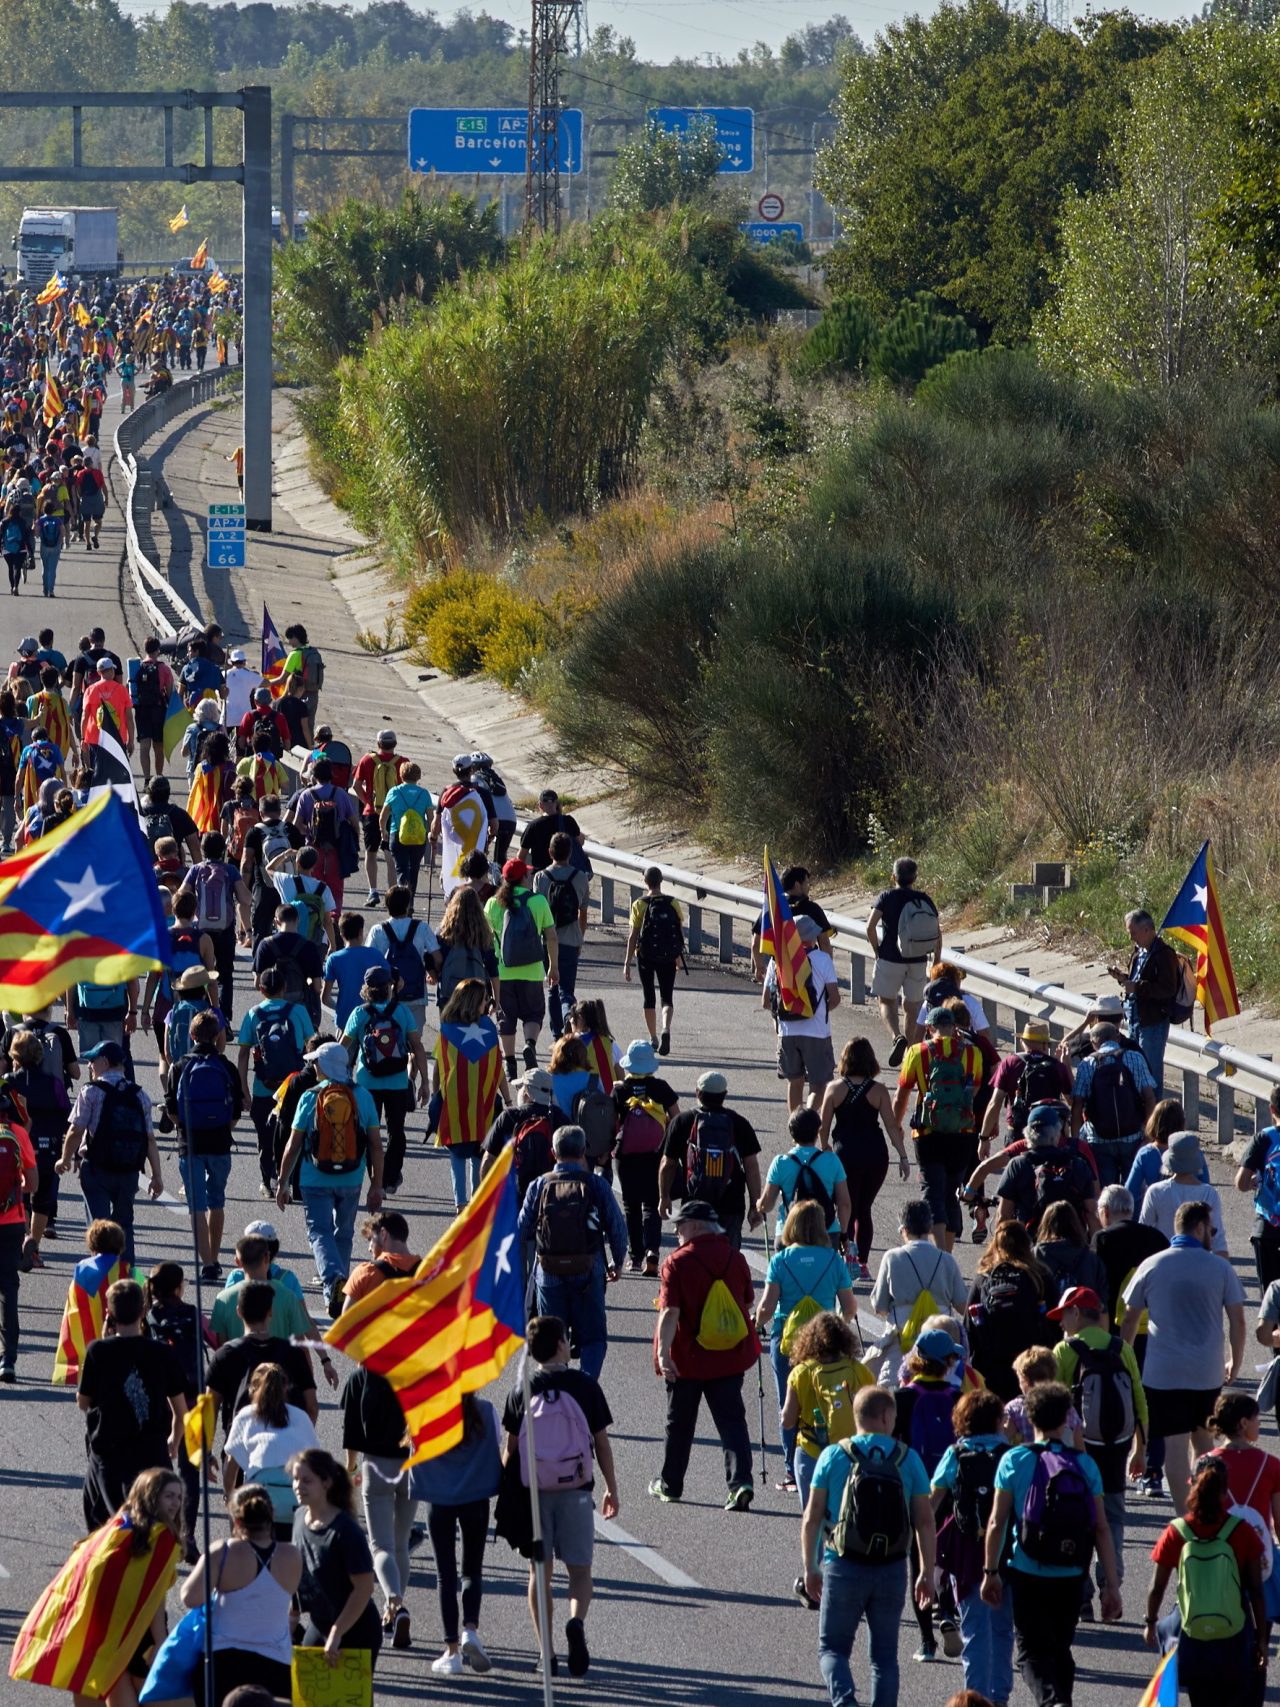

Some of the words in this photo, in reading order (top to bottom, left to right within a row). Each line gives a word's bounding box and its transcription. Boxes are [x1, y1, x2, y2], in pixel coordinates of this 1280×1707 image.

[458, 119, 484, 131] E-15
[214, 505, 239, 515] E-15
[213, 518, 240, 528] AP-7
[217, 531, 237, 540] A-2
[218, 553, 237, 564] 66
